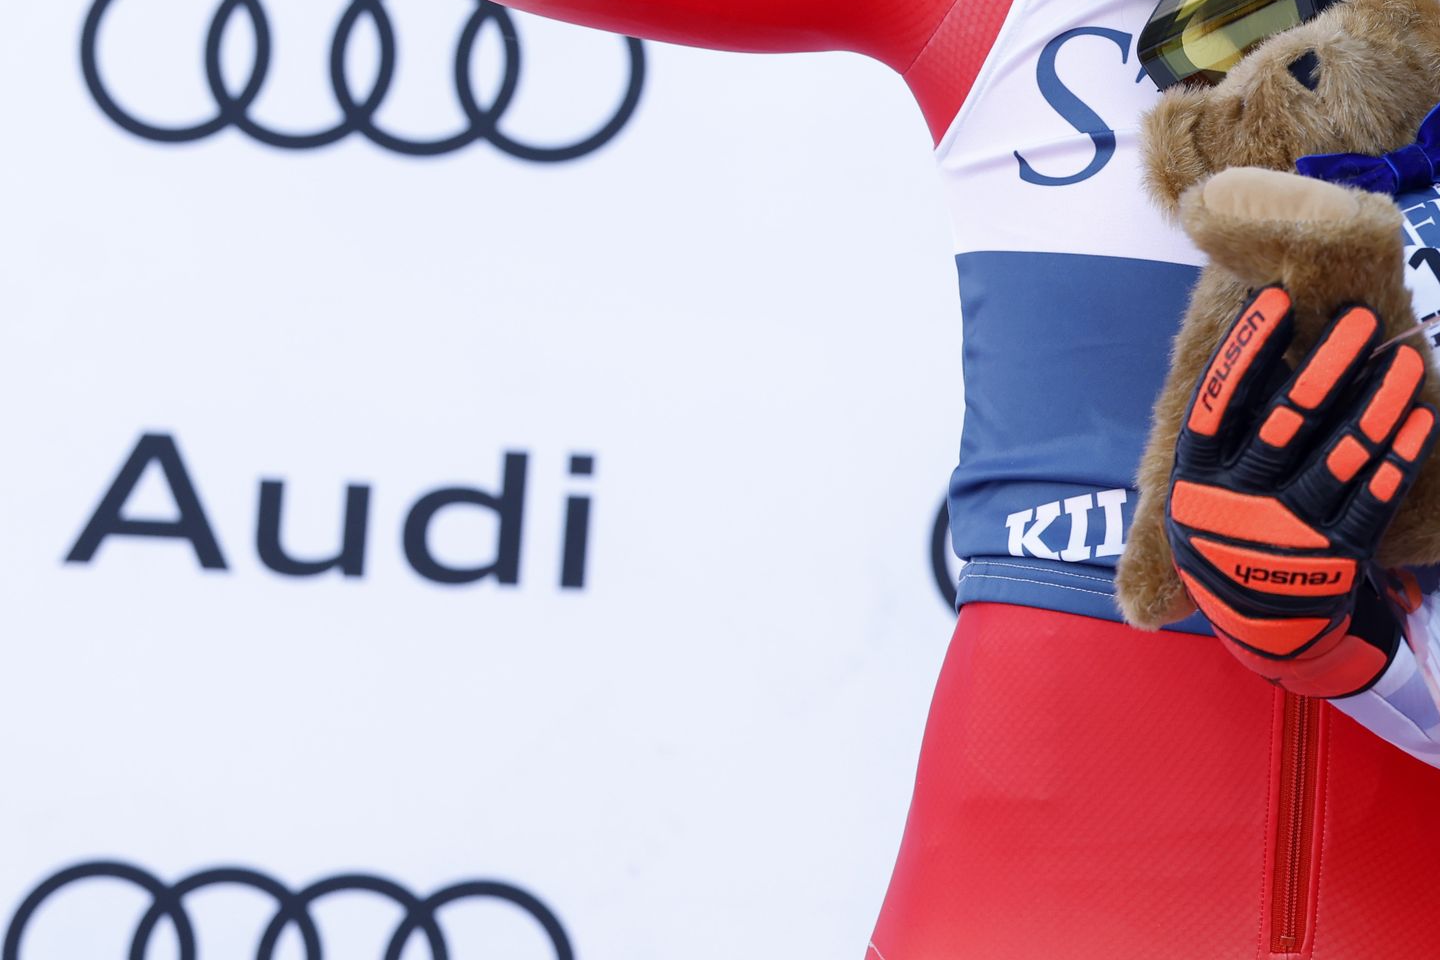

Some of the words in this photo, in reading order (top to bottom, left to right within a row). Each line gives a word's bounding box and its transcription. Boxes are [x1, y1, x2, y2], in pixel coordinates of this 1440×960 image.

[1014, 26, 1148, 187] S
[1200, 310, 1266, 412] reusch
[62, 432, 596, 589] Audi
[1235, 563, 1342, 585] reusch
